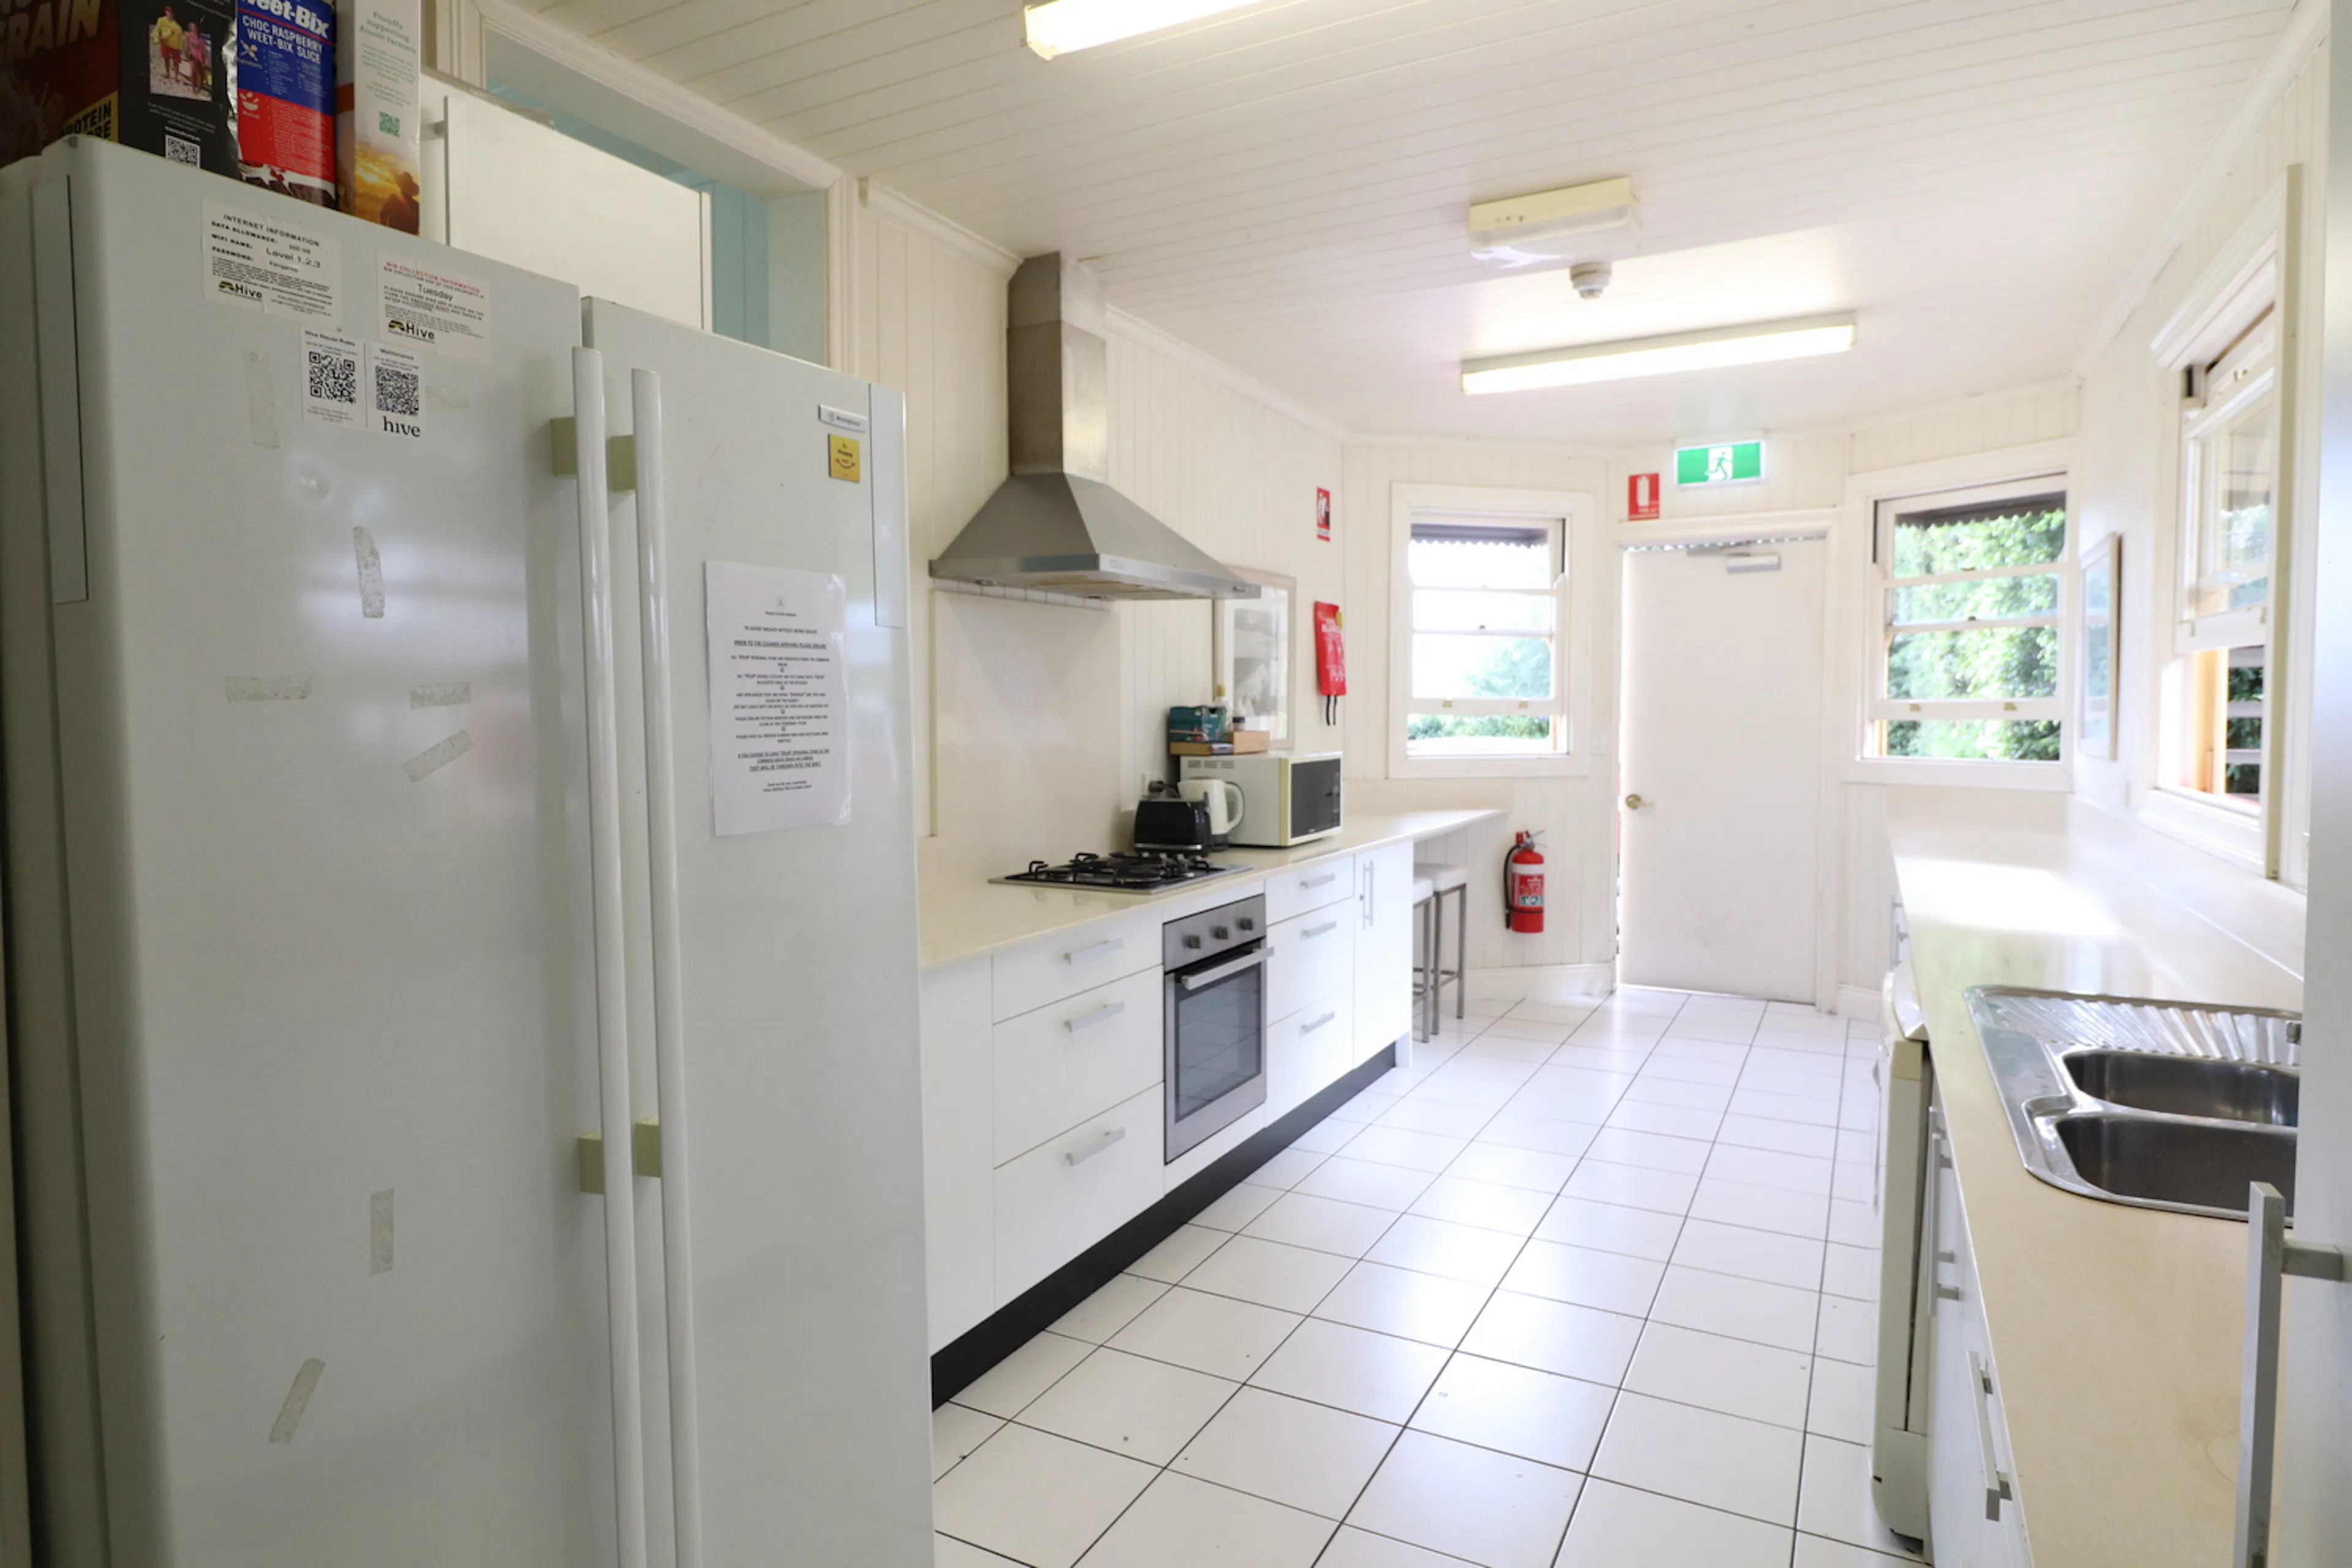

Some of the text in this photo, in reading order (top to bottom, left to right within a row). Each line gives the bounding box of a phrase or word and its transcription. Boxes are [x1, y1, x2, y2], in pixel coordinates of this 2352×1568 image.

[242, 0, 330, 39] eet-Bix
[0, 0, 102, 66] RAIN
[242, 15, 323, 54] CHOC RASPBERRY
[246, 28, 322, 65] WEET-BIX SLICE
[211, 221, 230, 231] DATA
[224, 214, 320, 247] INTERNET INFORMATION
[211, 233, 253, 249] WIFI NAME:
[266, 247, 294, 261] Level
[399, 265, 439, 281] COLLECTION
[235, 283, 263, 299] Hive
[417, 282, 454, 302] Tuesday
[405, 322, 435, 341] Hive
[383, 415, 421, 438] hive
